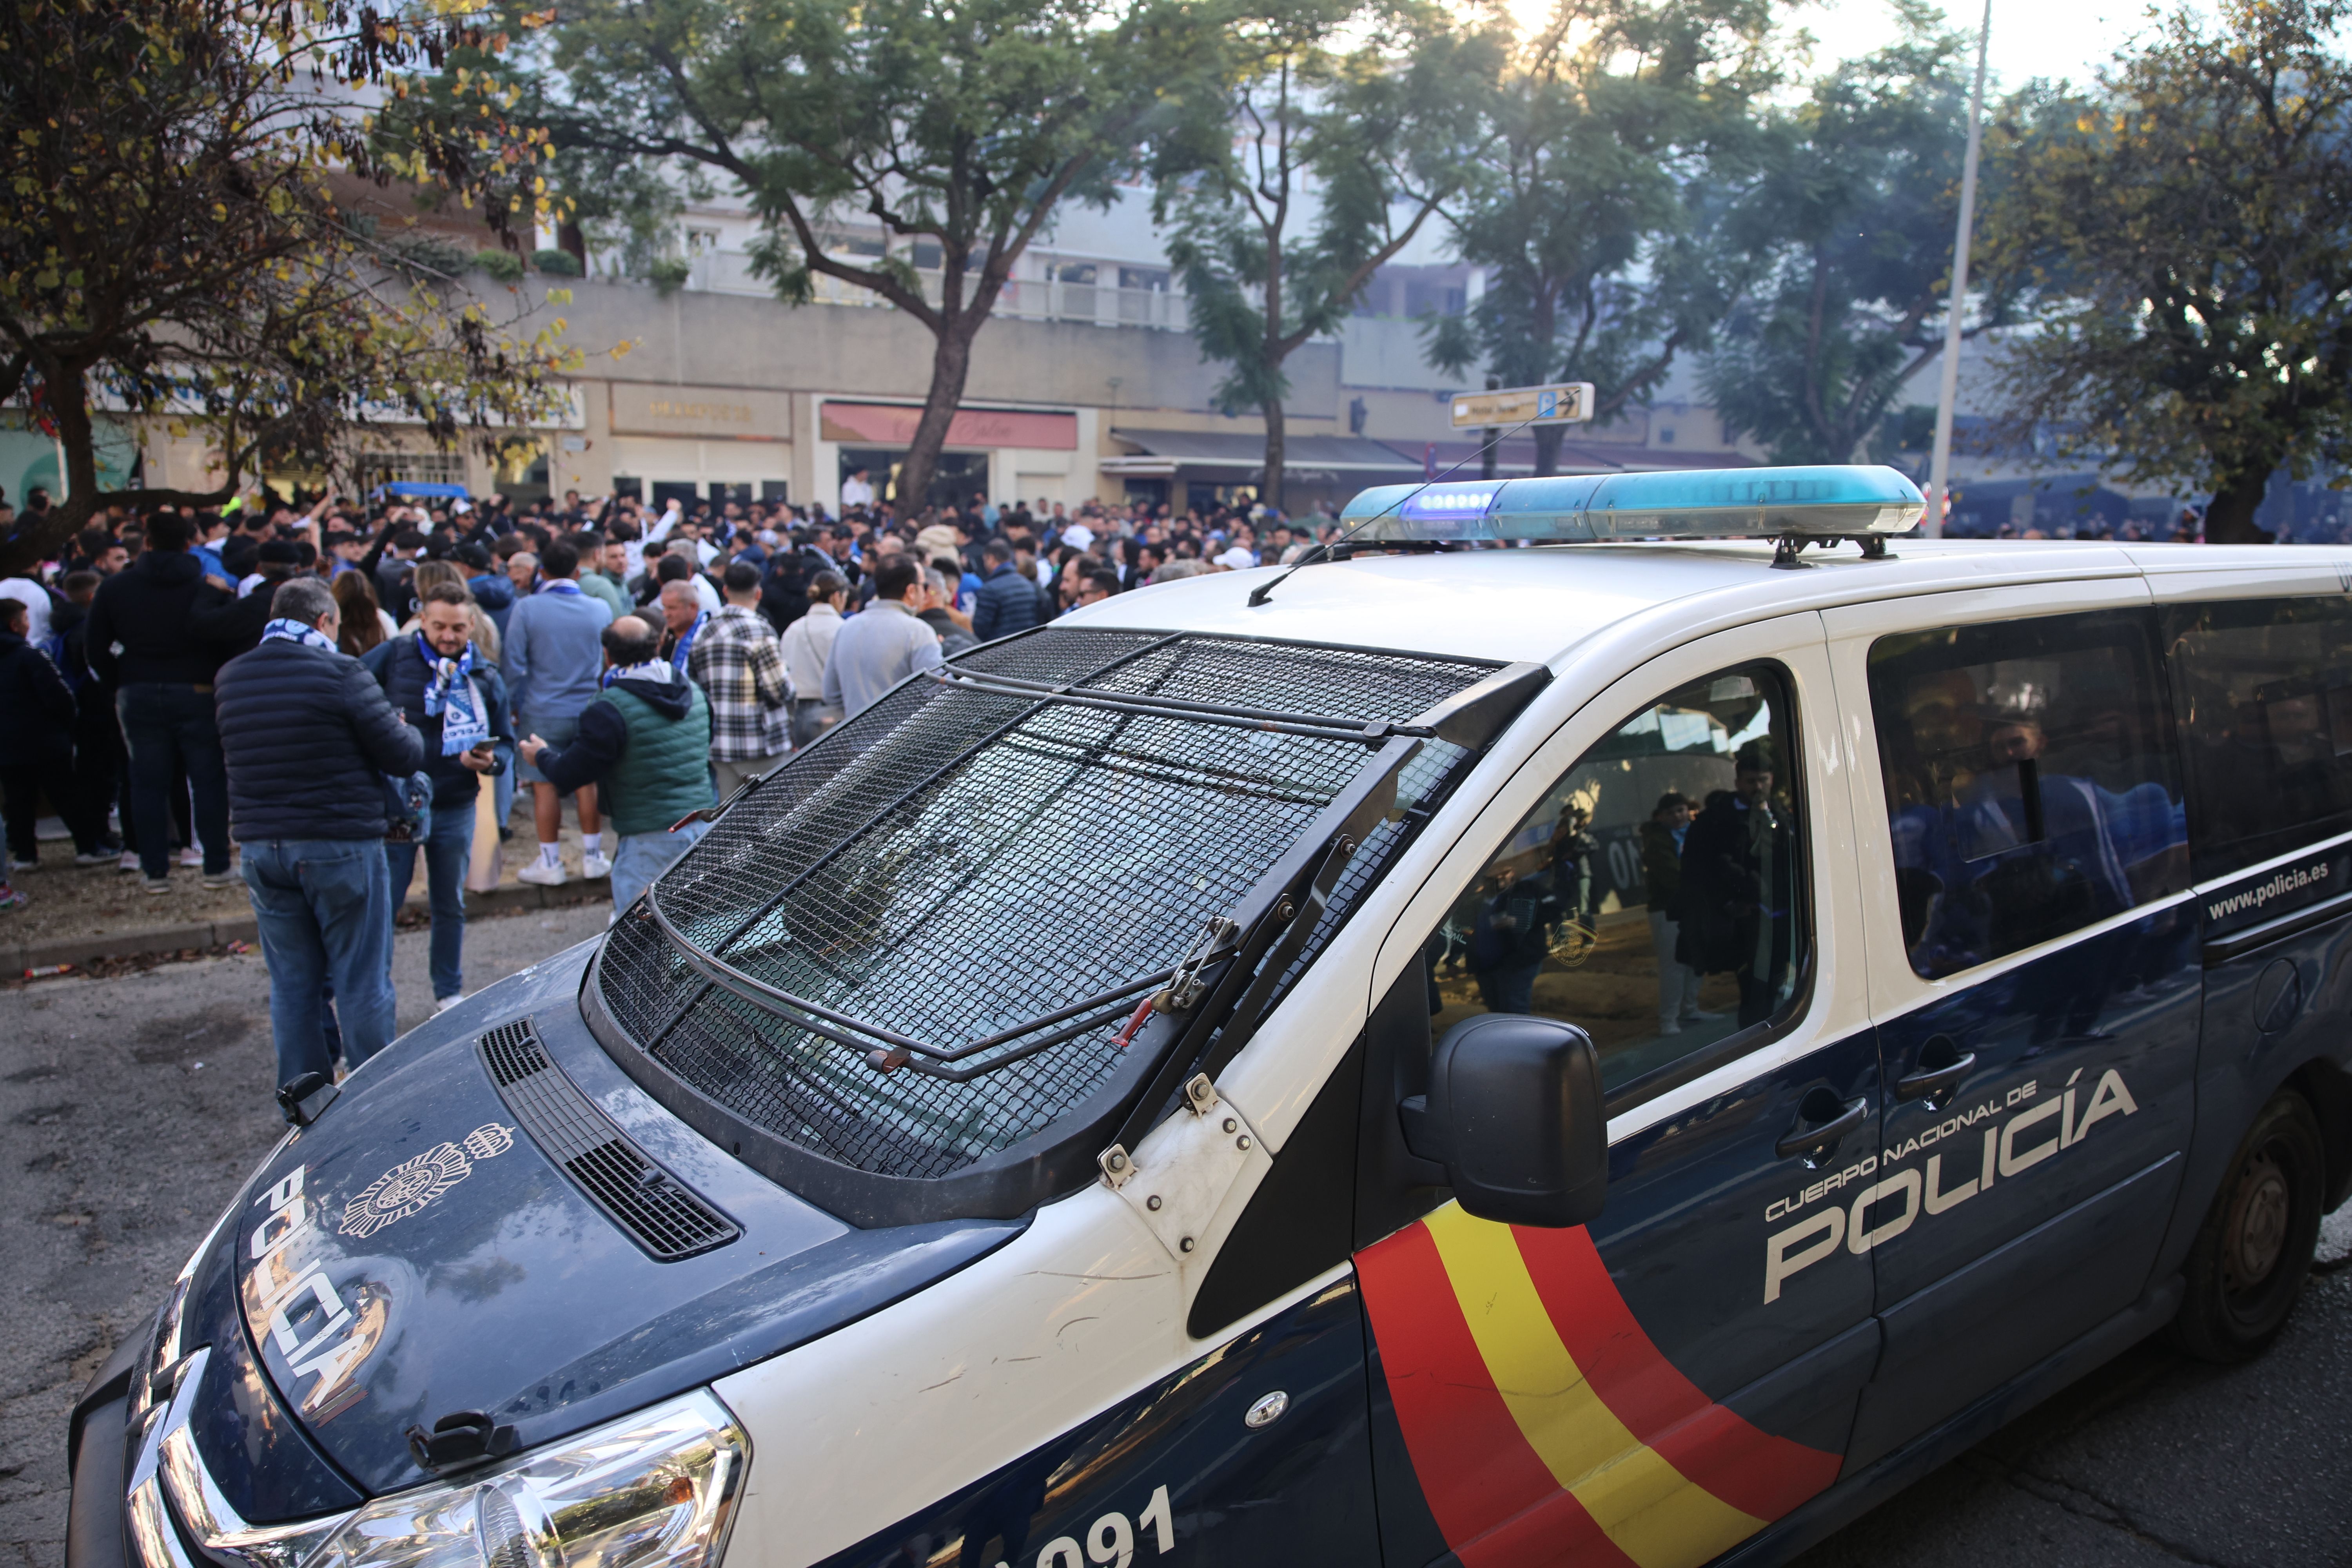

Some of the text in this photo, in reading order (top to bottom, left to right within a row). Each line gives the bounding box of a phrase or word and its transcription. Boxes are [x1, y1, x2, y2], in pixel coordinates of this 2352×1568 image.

[2209, 862, 2328, 920] www.policia.es
[1561, 951, 1588, 964] NACIONAL
[1765, 1080, 2037, 1222] CUERPO NACIONAL DE
[391, 1164, 428, 1183] CUERPO
[426, 1164, 442, 1187] NACIONAL
[410, 1192, 423, 1202] DE
[1764, 1067, 2138, 1305] POLICÍA
